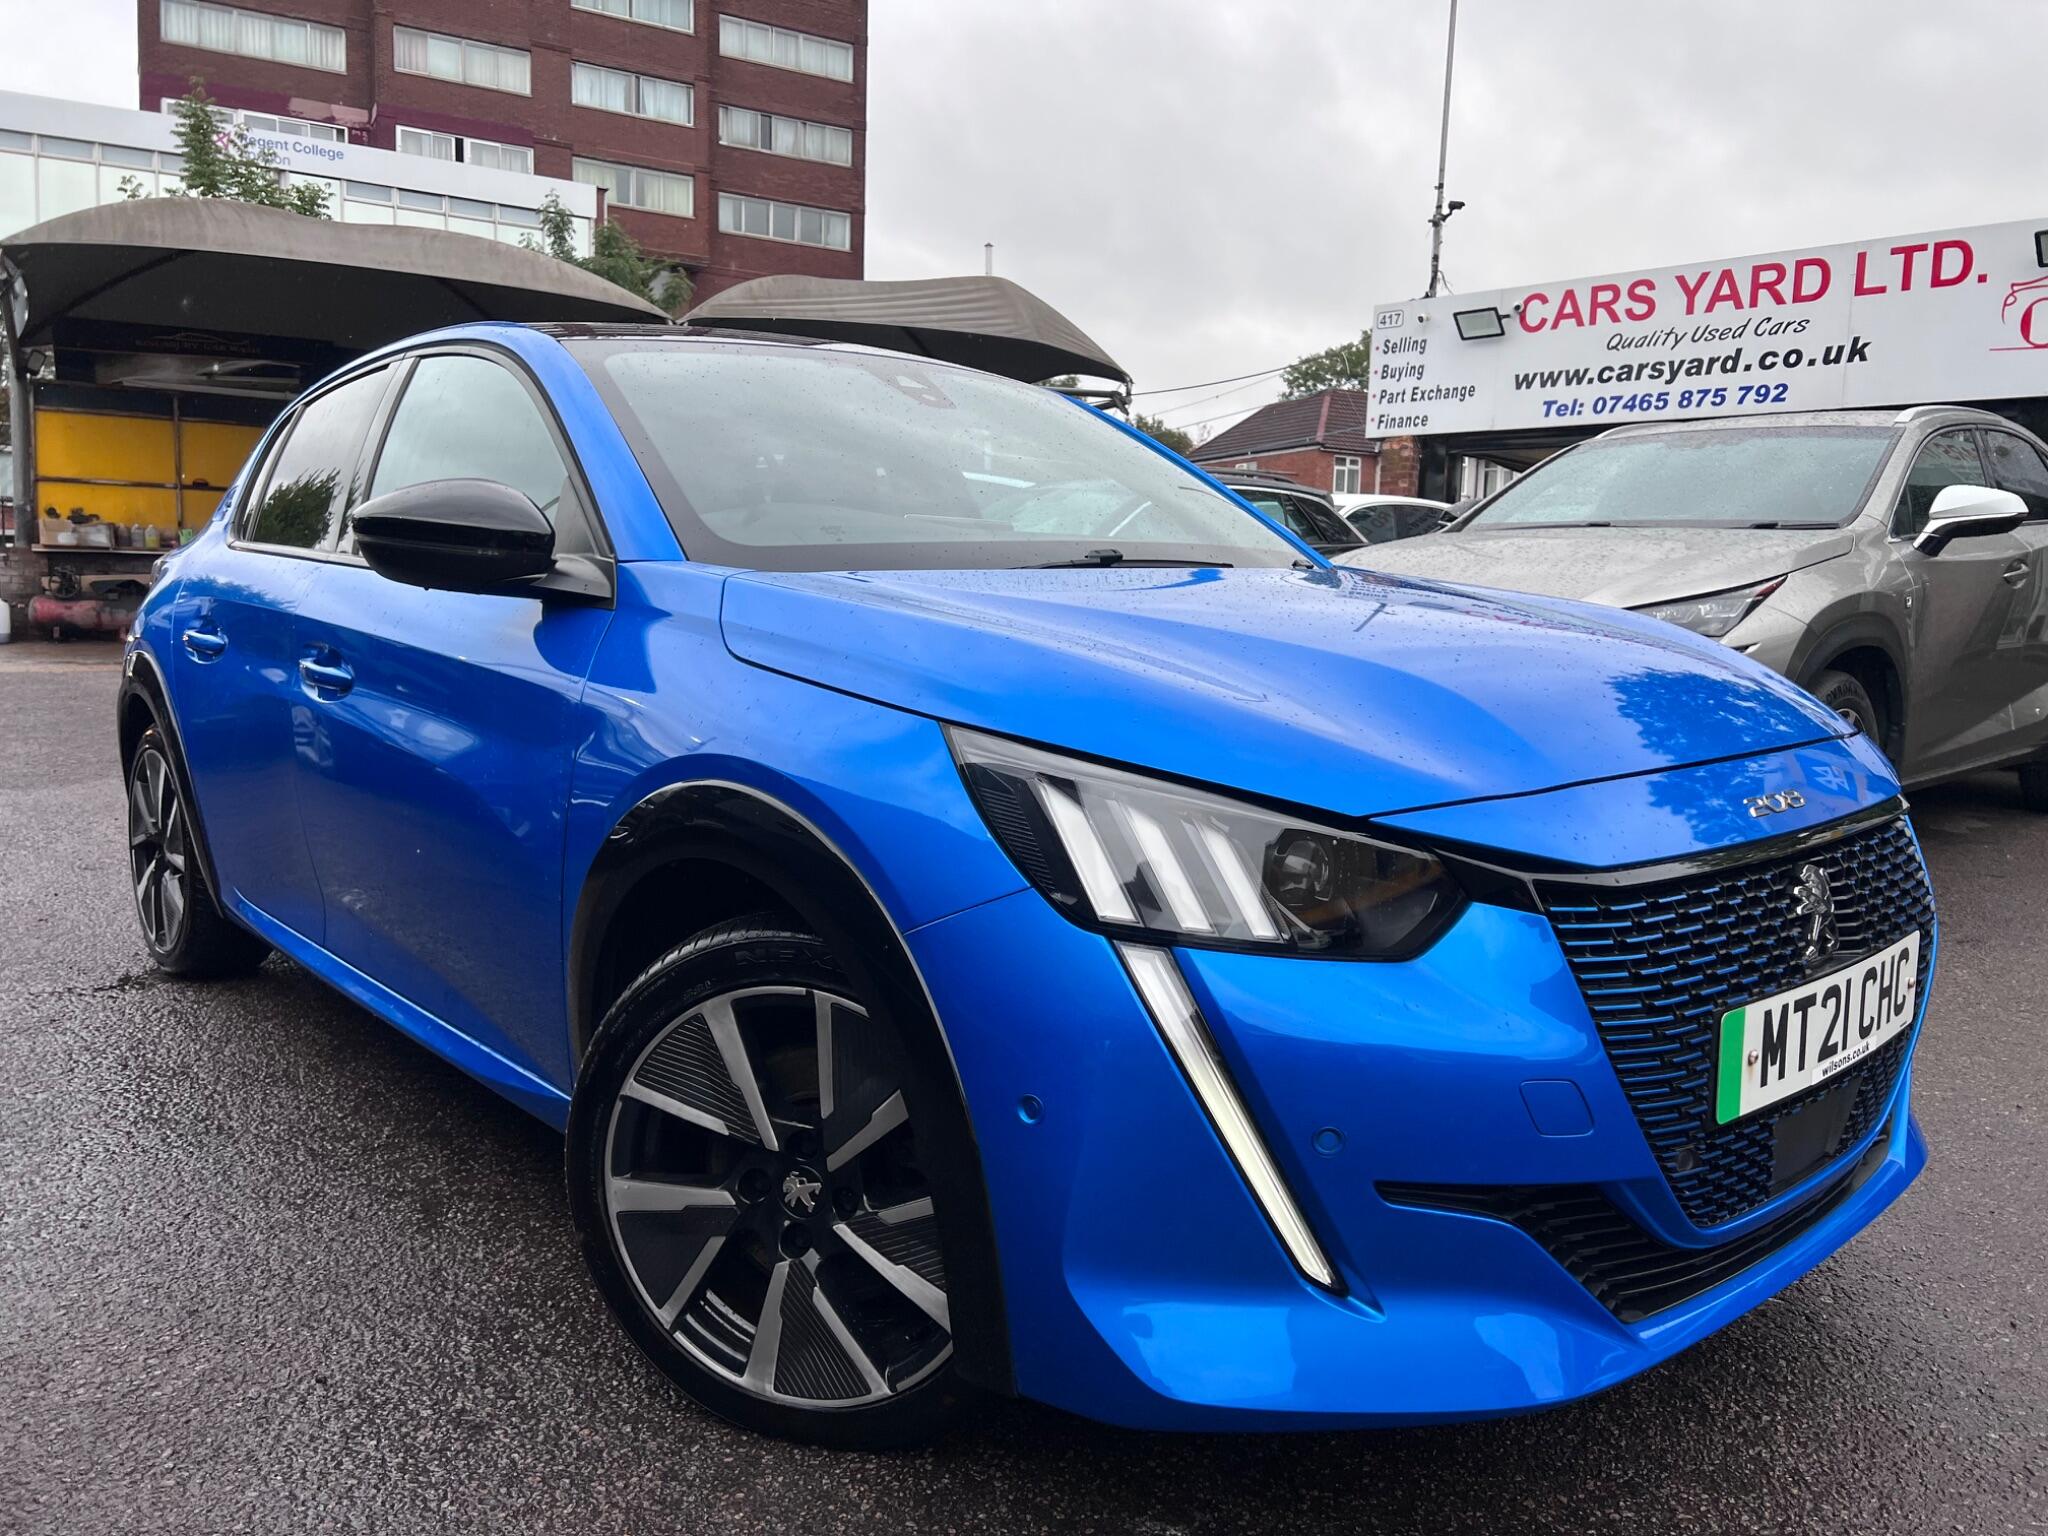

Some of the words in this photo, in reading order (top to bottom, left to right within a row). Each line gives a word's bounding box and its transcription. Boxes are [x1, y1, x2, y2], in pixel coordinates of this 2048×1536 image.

[293, 141, 345, 161] College
[1519, 279, 1657, 333] CARS
[1675, 257, 1832, 316] YARD
[1854, 239, 1988, 297] LTD.
[1379, 313, 1401, 326] 417
[1606, 327, 1688, 351] Quality
[1691, 317, 1753, 344] Used
[1754, 316, 1811, 337] Cars
[1382, 336, 1427, 355] Selling
[1381, 362, 1425, 382] Buying
[1514, 336, 1873, 390] www.carsyard.co.uk
[1379, 388, 1406, 405] Part
[1410, 384, 1476, 402] Exchange
[1543, 398, 1585, 418] Tel:
[1592, 391, 1670, 415] 07465
[1677, 386, 1728, 409] 875
[1737, 382, 1789, 405] 792
[1377, 413, 1429, 430] Finance
[1743, 789, 1806, 818] 208
[1760, 976, 1852, 1088] MT21
[1858, 946, 1910, 1040] CHC
[1821, 1041, 1870, 1078] wilsons.co.uk
